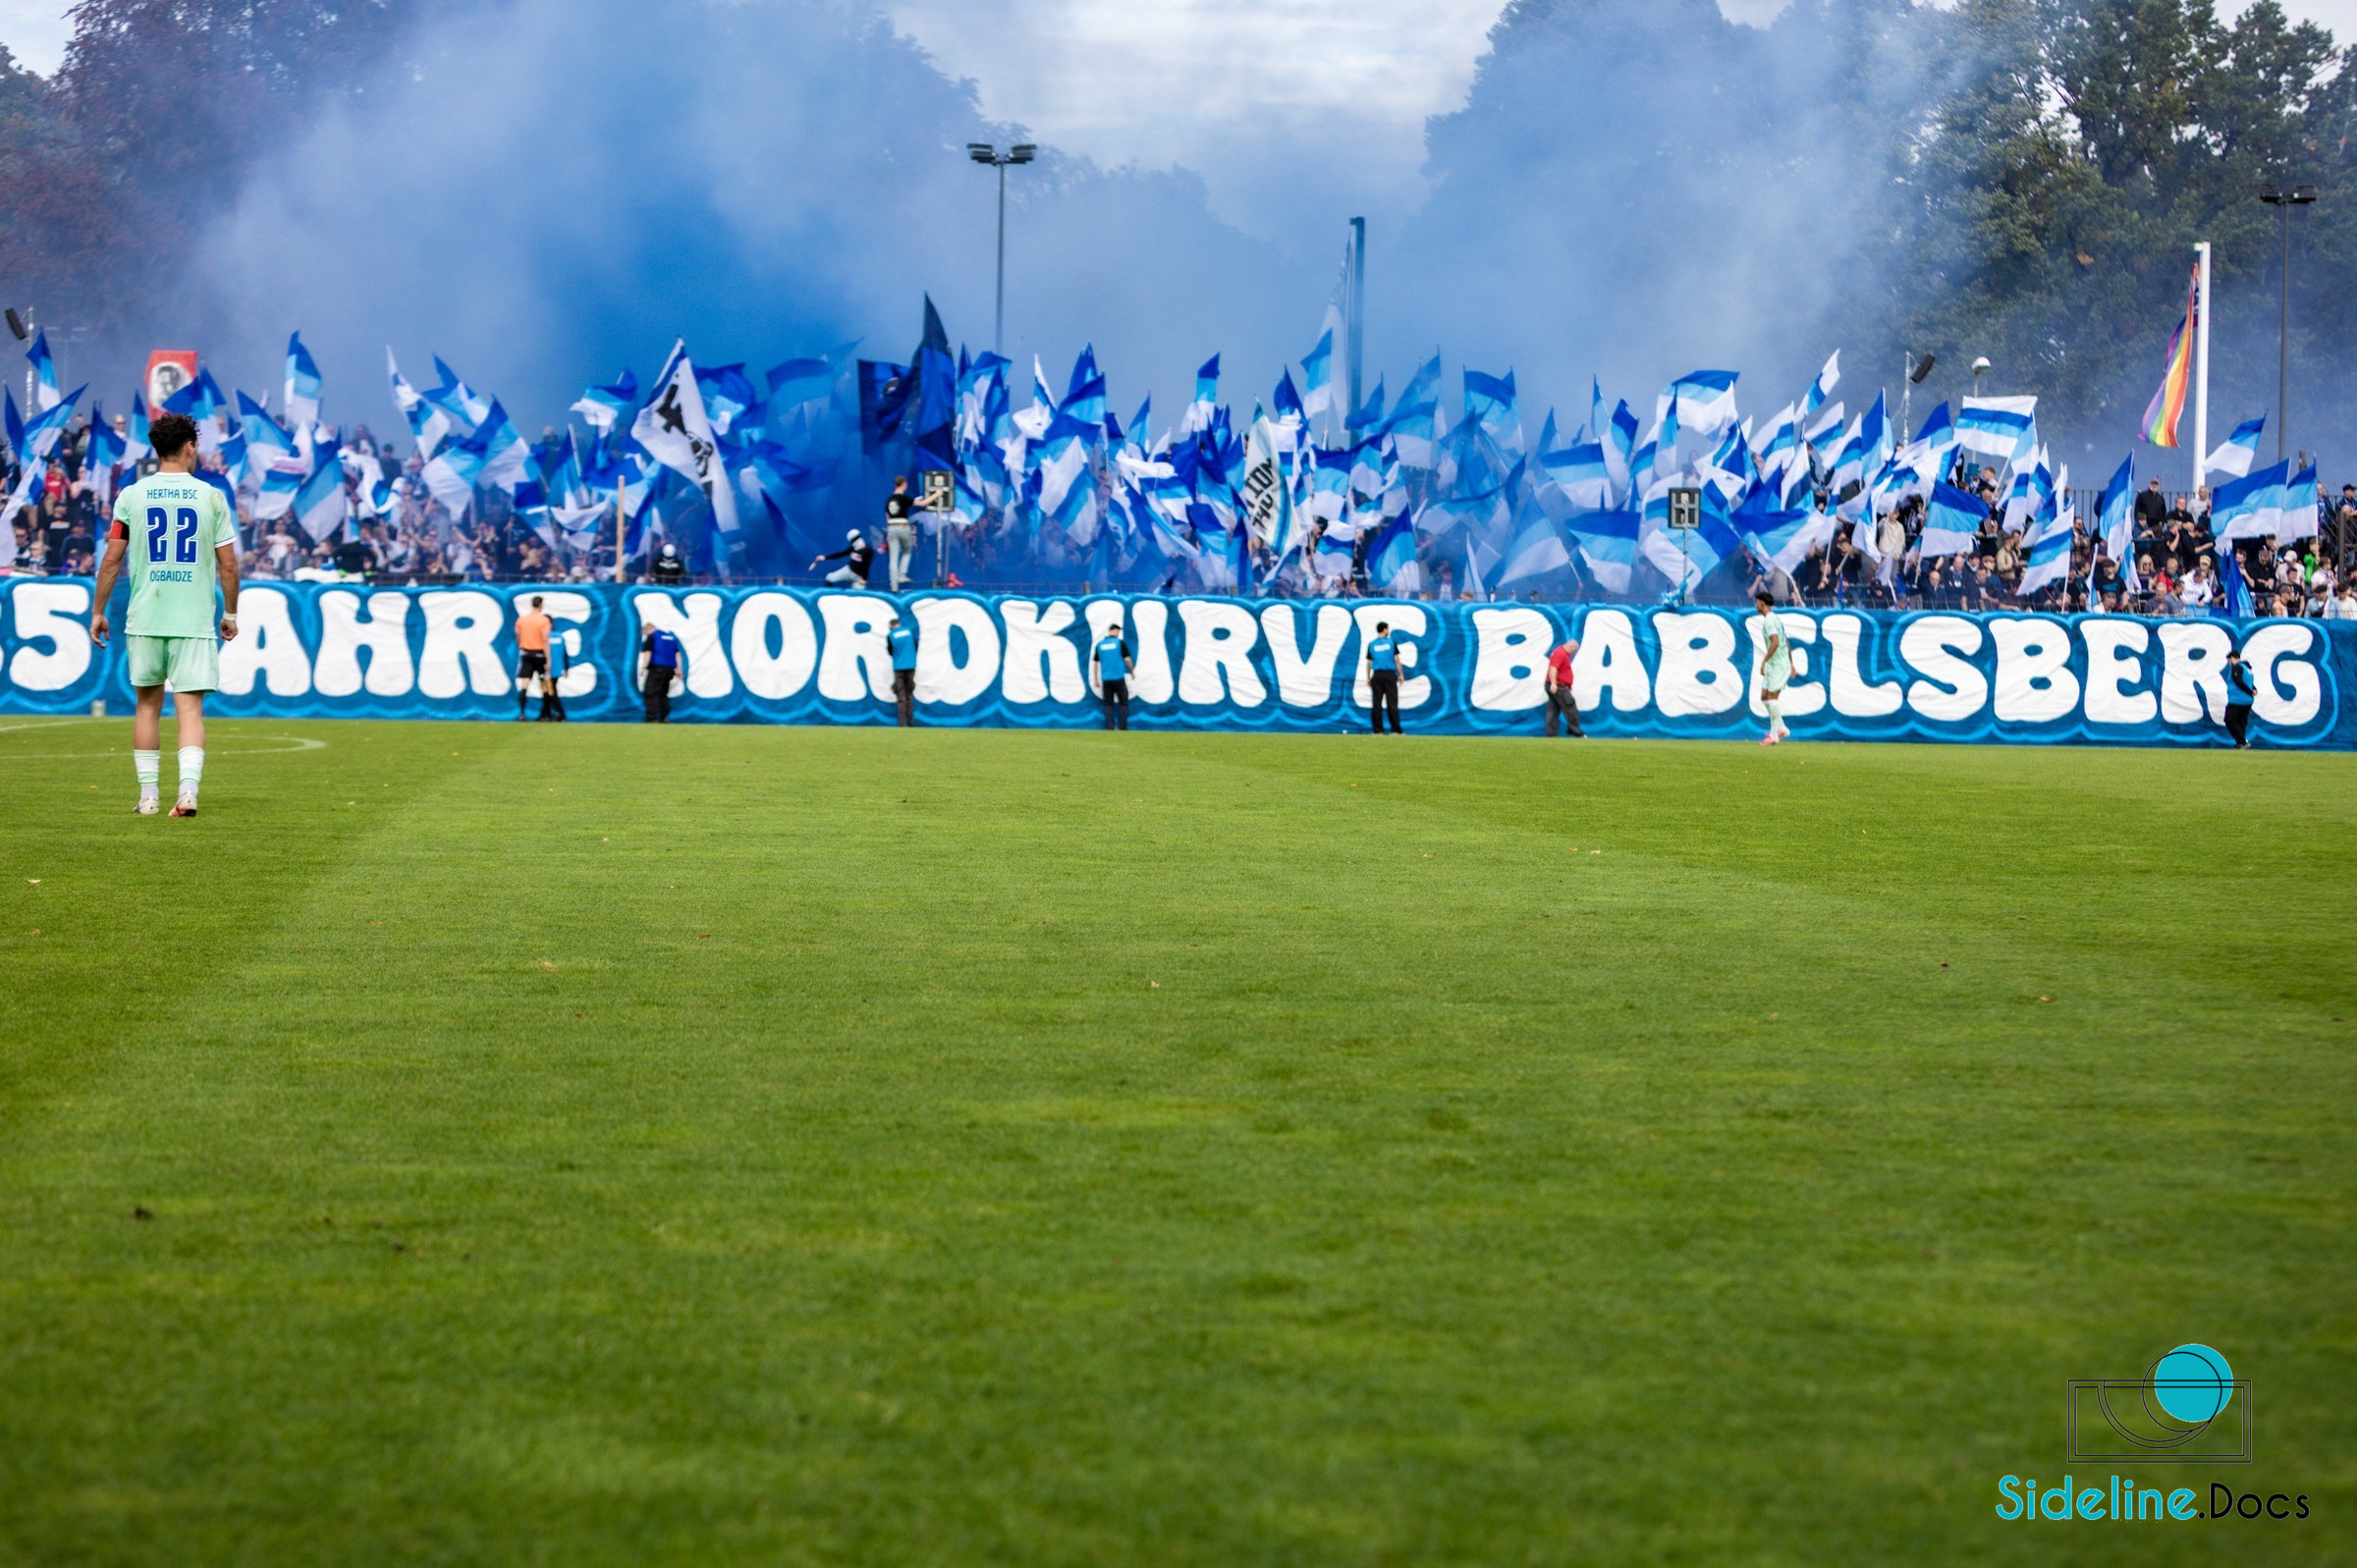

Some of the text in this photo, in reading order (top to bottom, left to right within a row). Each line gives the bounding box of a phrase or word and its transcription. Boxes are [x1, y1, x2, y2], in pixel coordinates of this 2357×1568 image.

[146, 489, 197, 499] HERTHA BSC
[145, 506, 198, 564] 22
[149, 570, 192, 581] OGBAIDZE
[0, 583, 2321, 725] 5 AHRE NORDKURVE BABELSBERG
